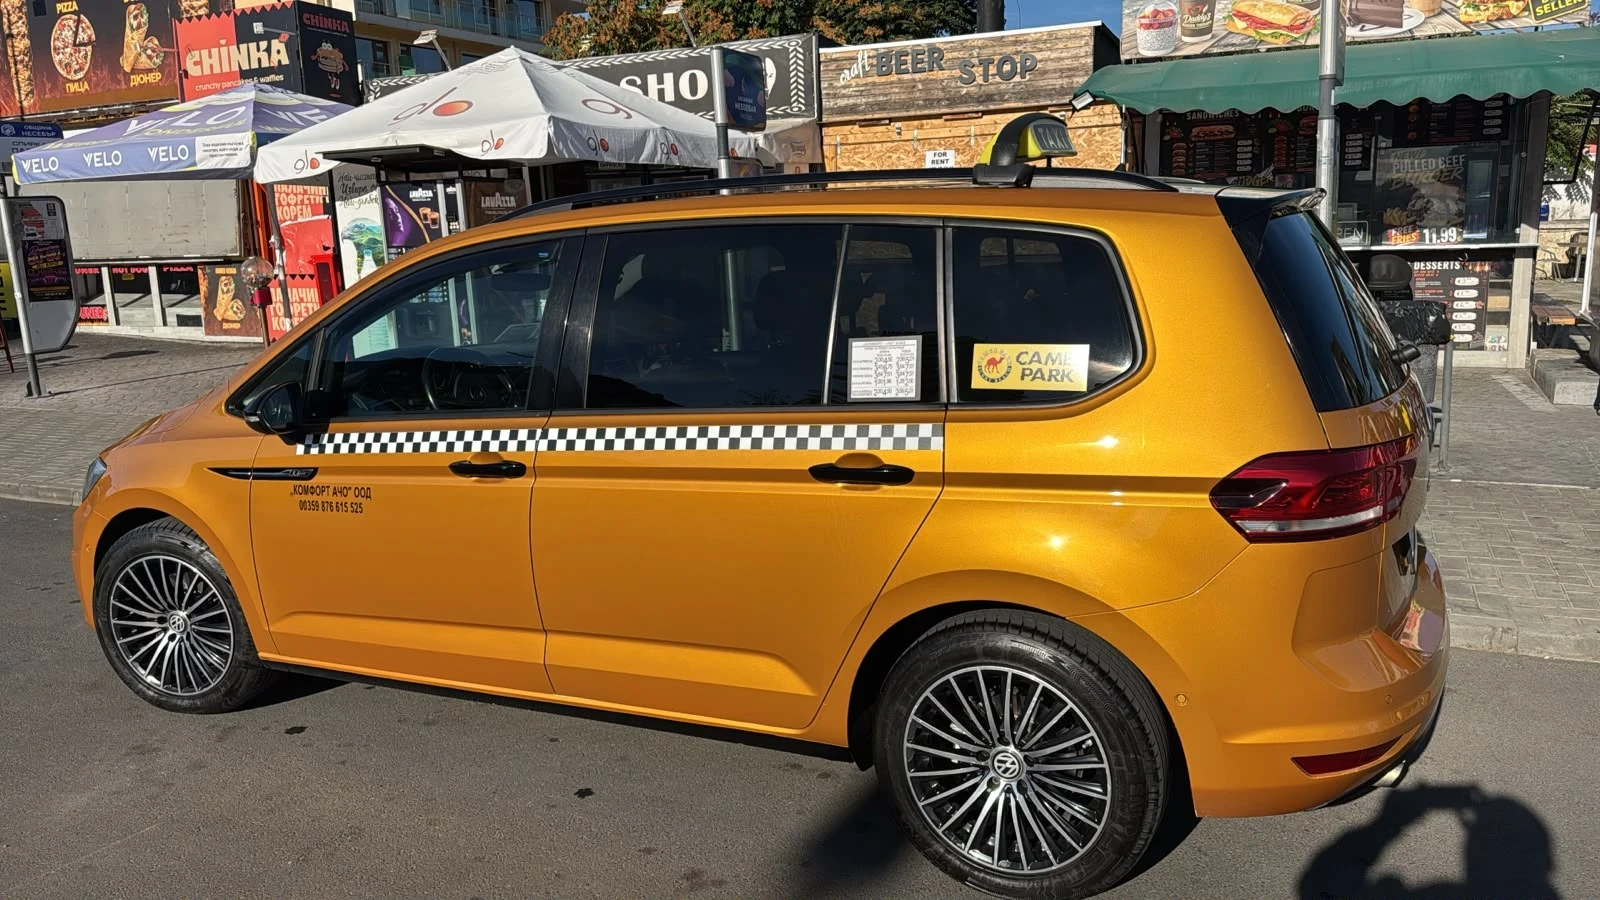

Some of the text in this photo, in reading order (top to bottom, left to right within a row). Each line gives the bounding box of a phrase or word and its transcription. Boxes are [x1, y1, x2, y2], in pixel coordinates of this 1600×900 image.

[56, 1, 78, 14] PIZZA
[839, 47, 1037, 85] craft BEER STOP
[65, 82, 90, 93] ПИЦА
[130, 72, 162, 87] ДЮНЕР
[196, 82, 221, 92] crunchy
[260, 74, 284, 83] waffles
[619, 69, 708, 102] SHO
[1038, 127, 1069, 149] TAXI
[83, 150, 122, 168] VELO
[147, 144, 189, 162] VELO
[21, 157, 59, 173] VELO
[1392, 154, 1466, 174] PULLED BEEF
[481, 192, 517, 208] LAVAZZA
[1422, 227, 1457, 244] 11.99
[1413, 261, 1460, 270] DESSERTS
[1016, 351, 1074, 366] CAME
[1020, 367, 1074, 383] PARK
[354, 487, 372, 501] ООД
[299, 500, 363, 514] 00359 876 615 525
